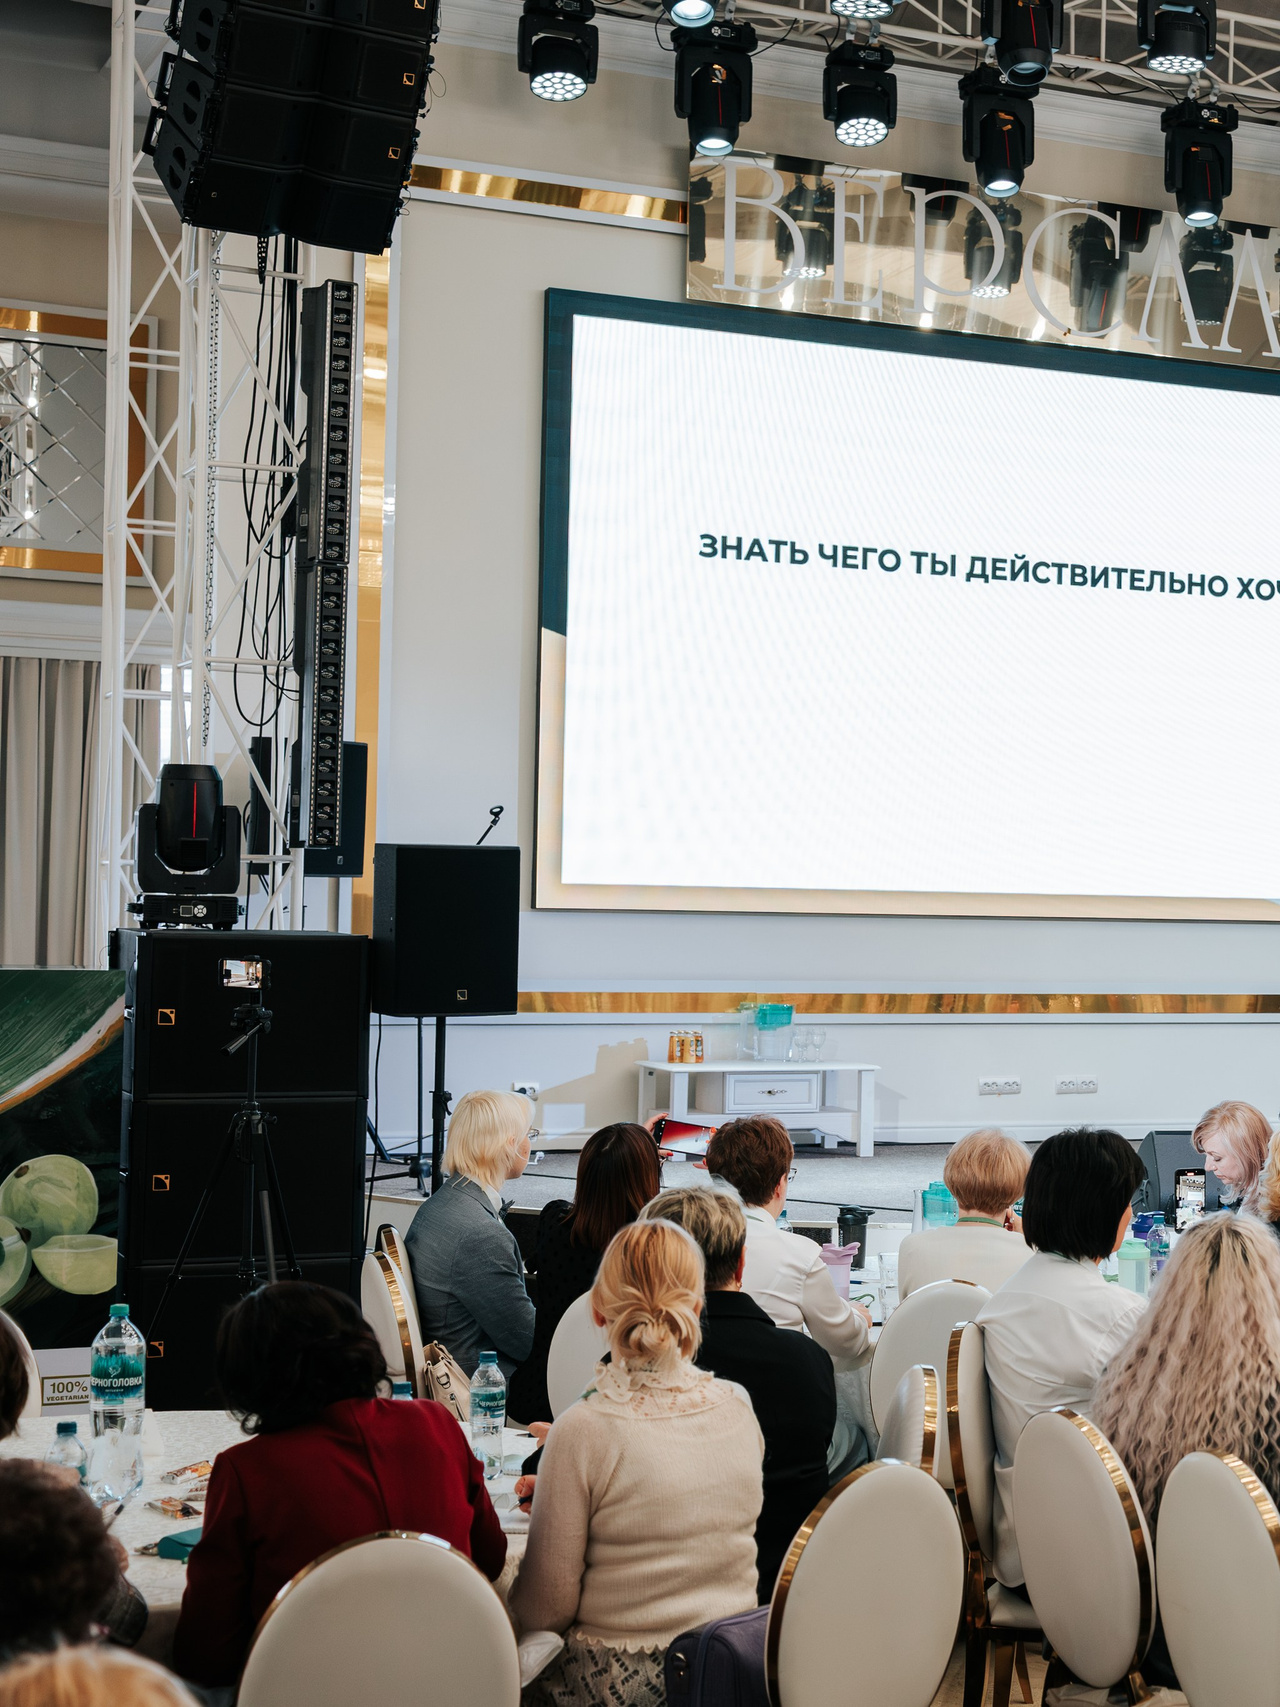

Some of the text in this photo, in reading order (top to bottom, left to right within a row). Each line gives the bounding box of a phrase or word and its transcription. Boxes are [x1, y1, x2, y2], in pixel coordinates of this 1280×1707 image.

[698, 533, 809, 565] ЗНАТЬ
[817, 543, 901, 573] ЧЕГО
[910, 551, 957, 578] ТЫ
[965, 553, 1229, 598] ДЕЙСТВИТЕЛЬНО
[50, 1380, 88, 1394] 100%
[46, 1394, 89, 1402] VEGETARIAN
